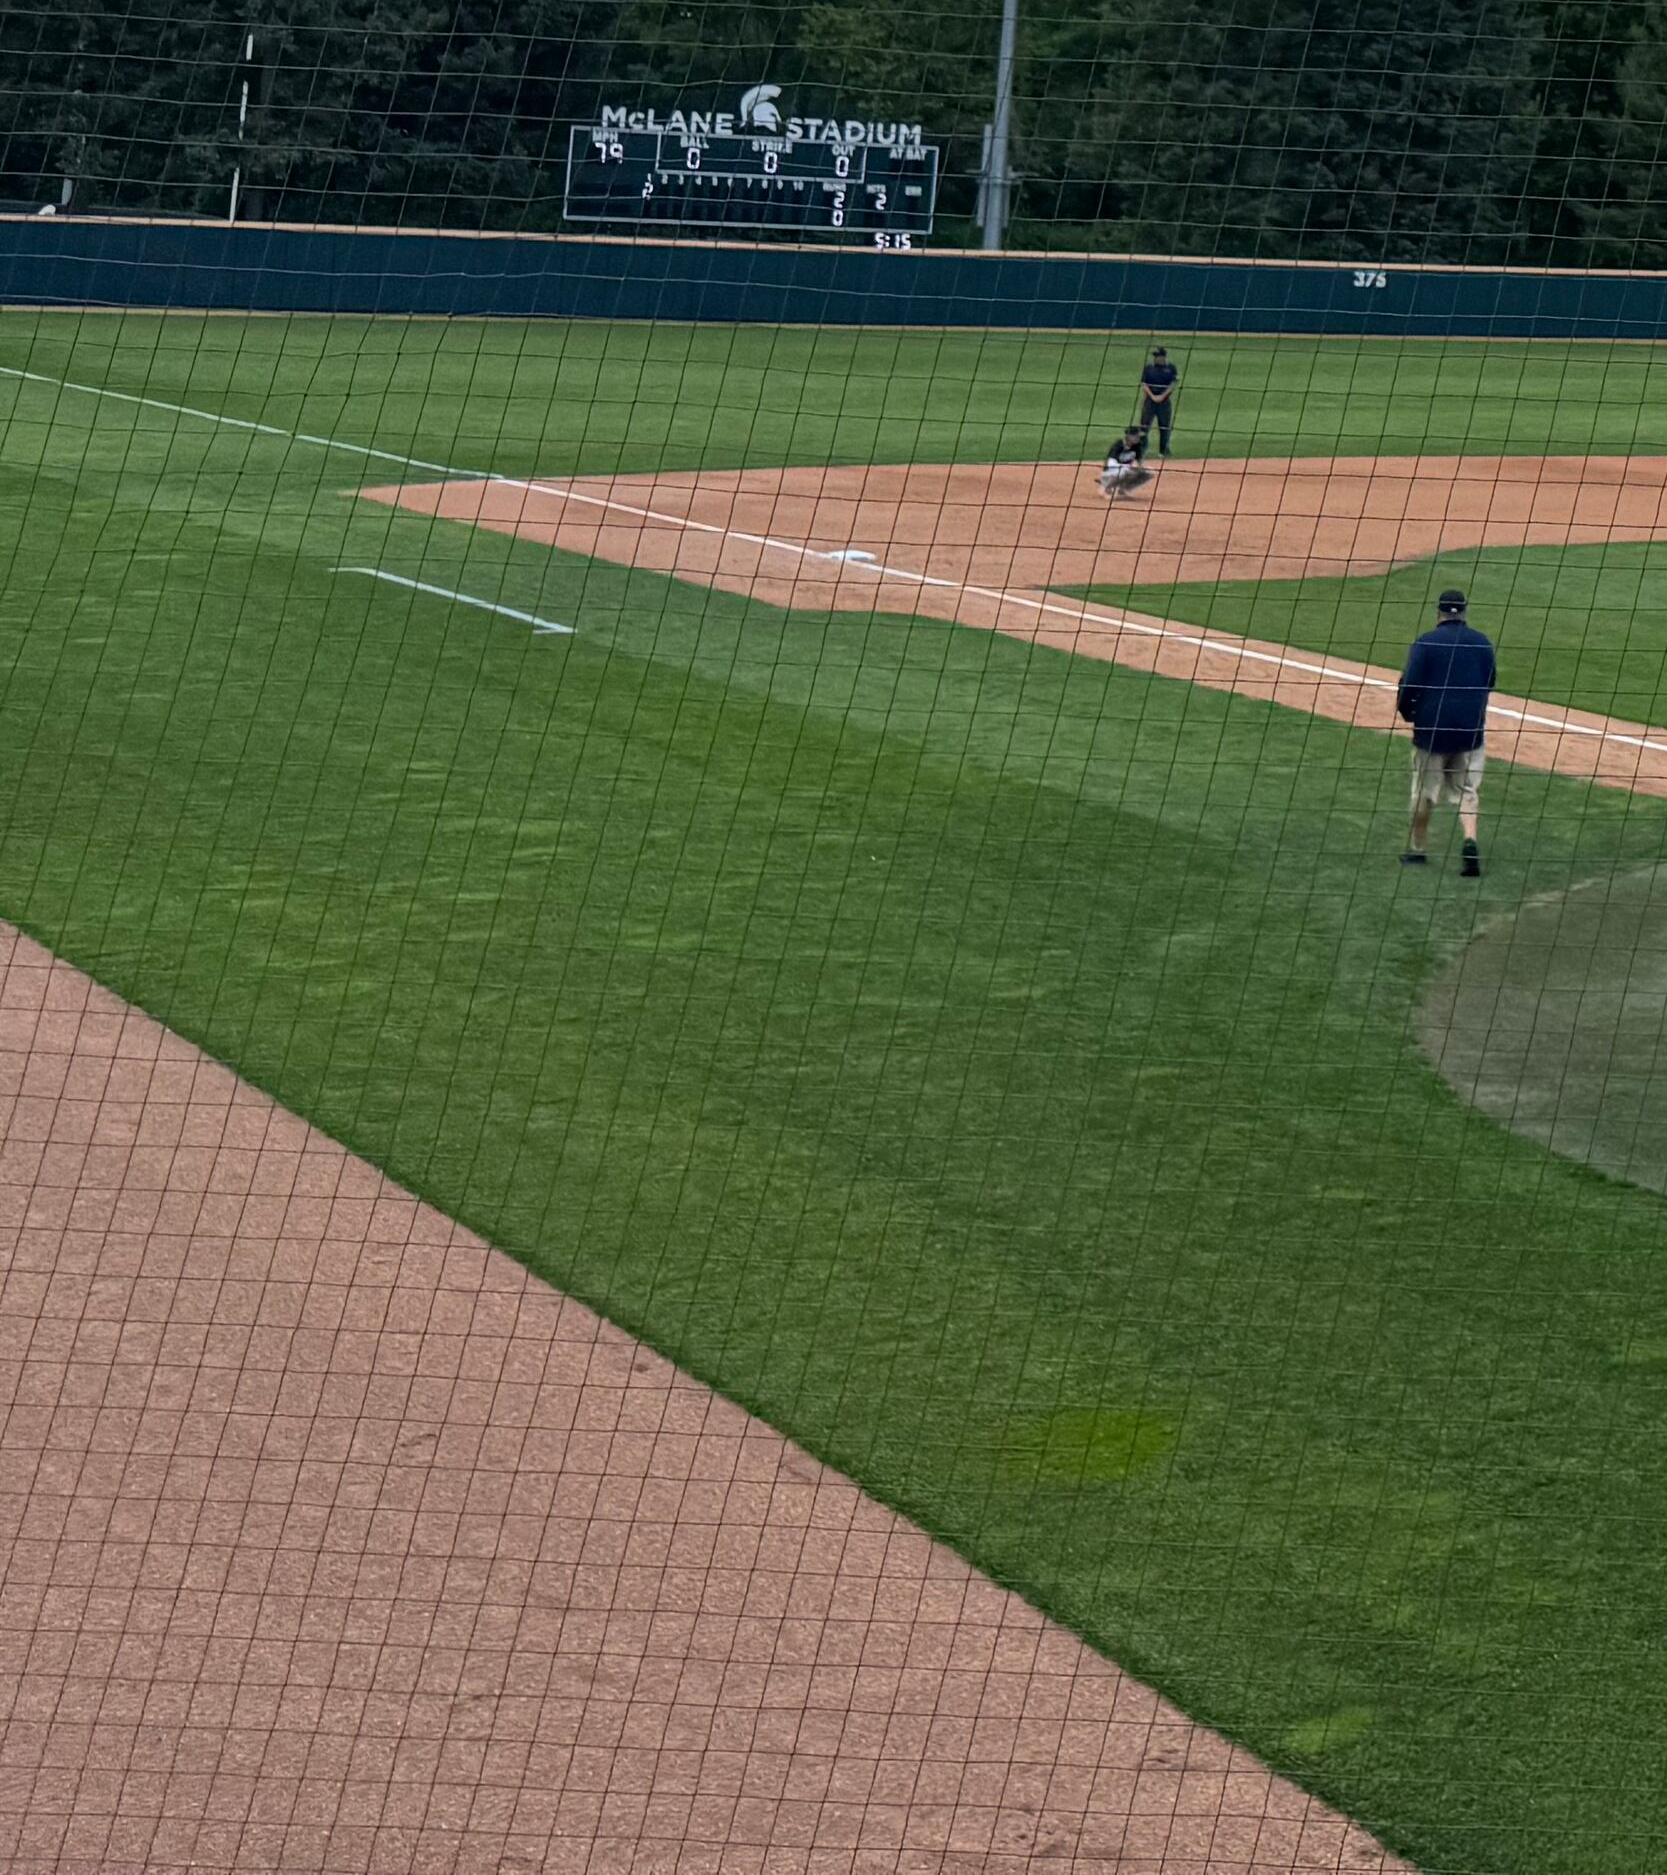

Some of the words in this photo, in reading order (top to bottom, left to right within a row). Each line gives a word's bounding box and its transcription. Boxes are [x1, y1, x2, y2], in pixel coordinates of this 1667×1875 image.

[592, 127, 619, 143] MPH
[601, 104, 735, 136] McLANE
[785, 116, 922, 146] STADIUM
[680, 134, 709, 149] BALL
[831, 143, 856, 157] OUT
[594, 141, 624, 165] 79
[686, 147, 701, 170] 0
[763, 151, 778, 174] 0
[835, 156, 850, 178] 0
[833, 191, 845, 209] 2
[875, 193, 887, 211] 2
[832, 209, 844, 227] 0
[1353, 271, 1387, 288] 375
